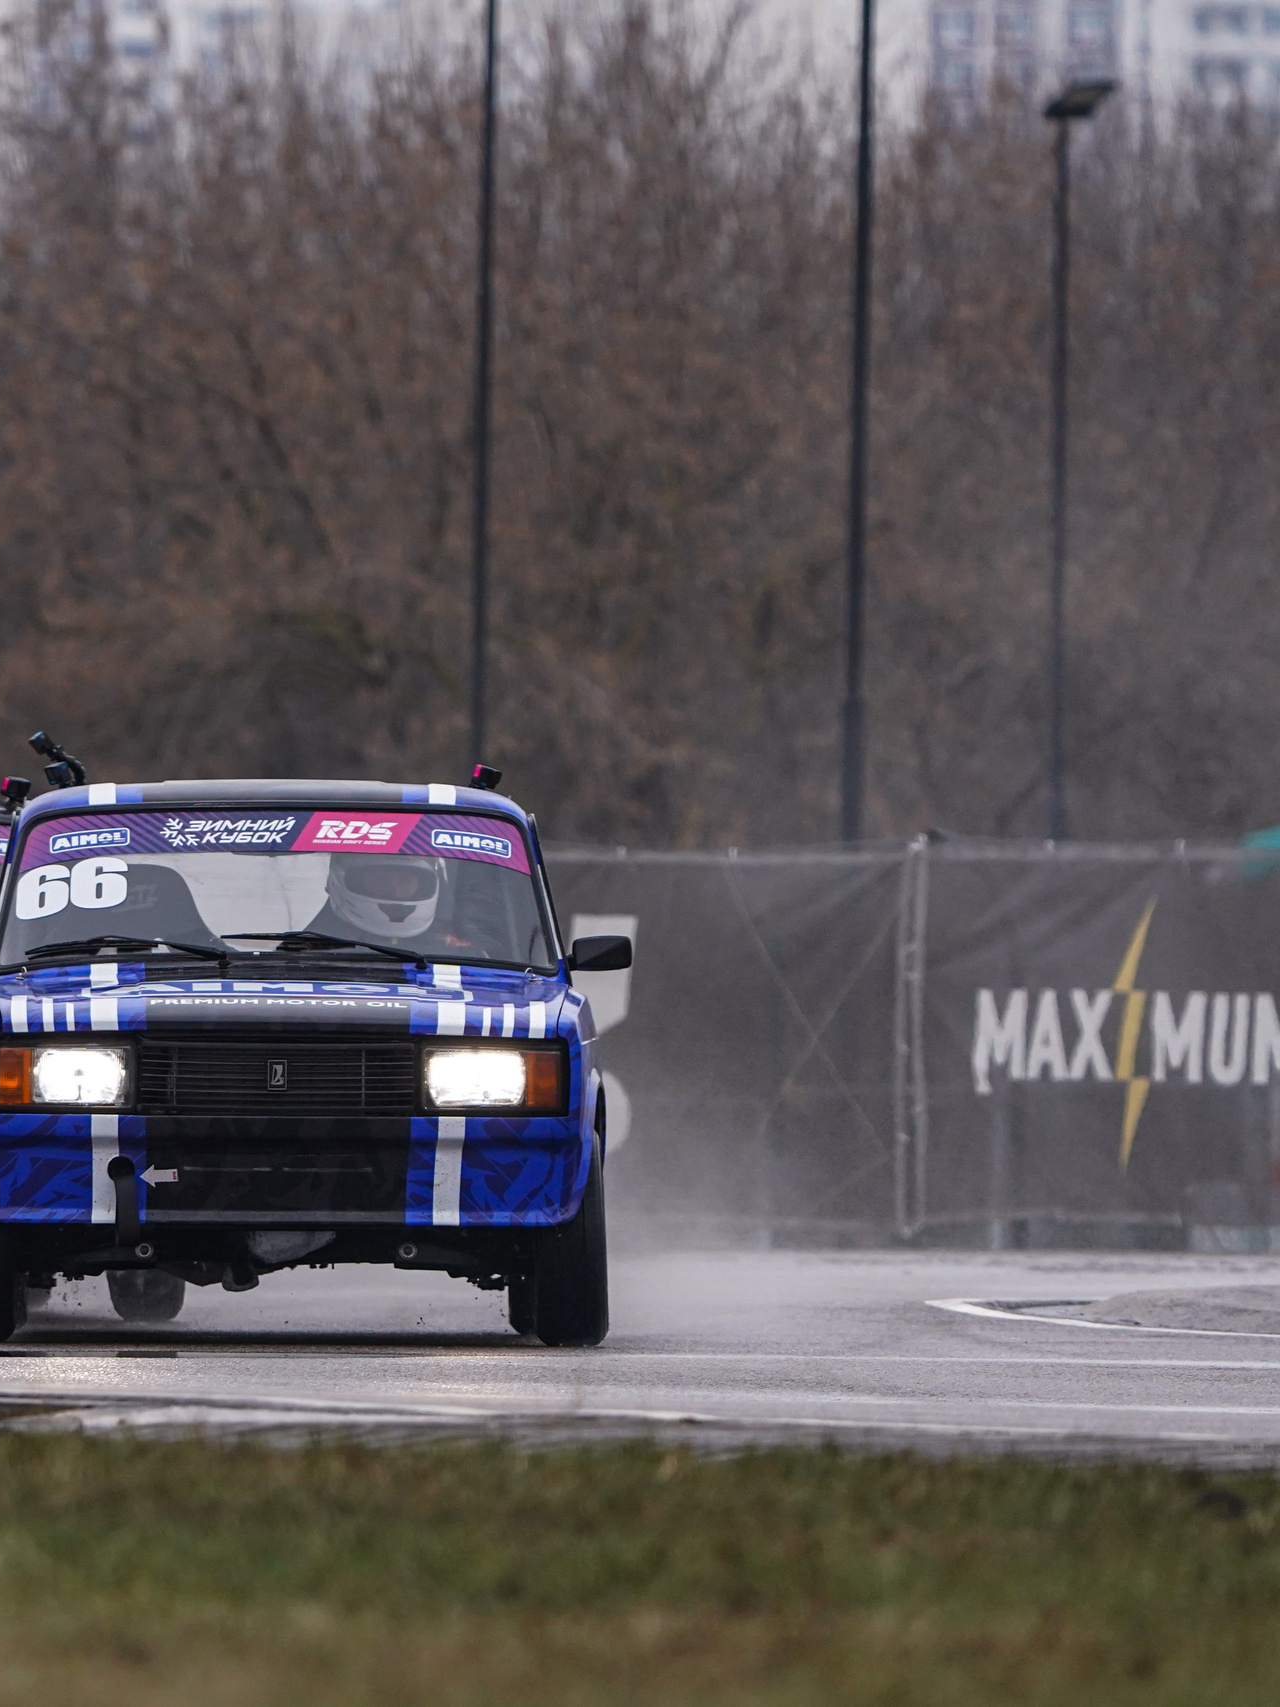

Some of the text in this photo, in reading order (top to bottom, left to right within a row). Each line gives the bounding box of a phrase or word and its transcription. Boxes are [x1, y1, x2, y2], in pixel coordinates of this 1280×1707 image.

[185, 816, 297, 832] ЗИМНИЙ
[315, 820, 399, 840] RDS
[53, 831, 126, 850] AIMOL
[201, 831, 291, 844] КУБОК
[435, 833, 508, 856] AIMOL
[15, 856, 129, 920] 66
